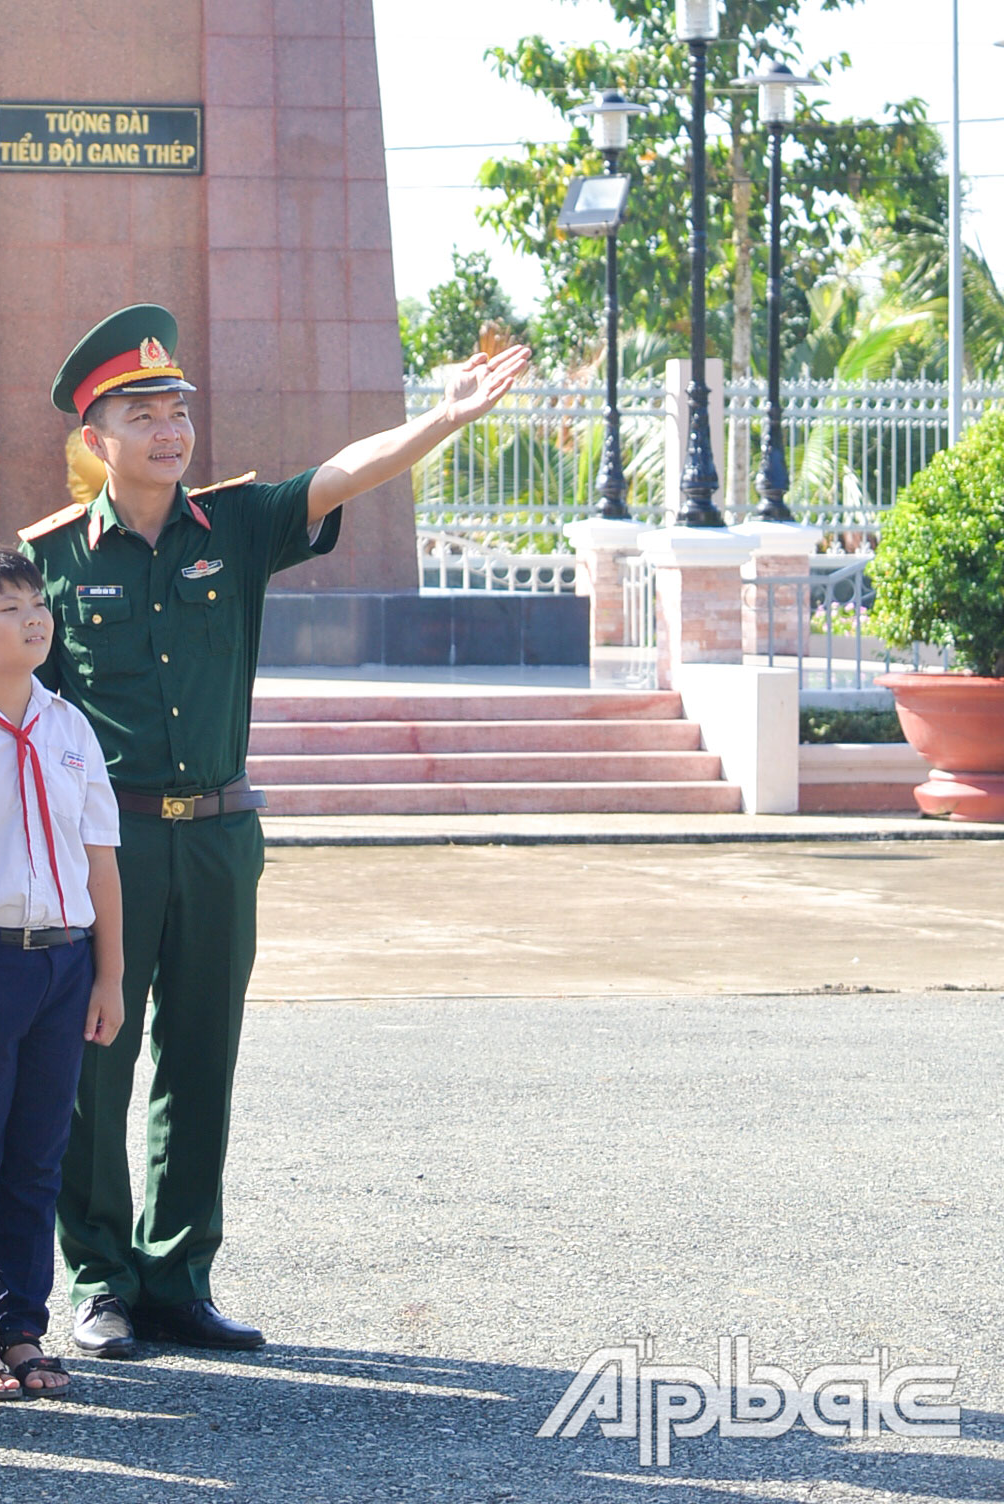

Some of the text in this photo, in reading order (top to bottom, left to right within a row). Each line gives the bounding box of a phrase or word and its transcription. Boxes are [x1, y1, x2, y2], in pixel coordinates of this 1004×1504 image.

[46, 109, 149, 137] TƯỢNG ĐÀI
[0, 132, 195, 166] TIỂU ĐỘI GANG THÉP
